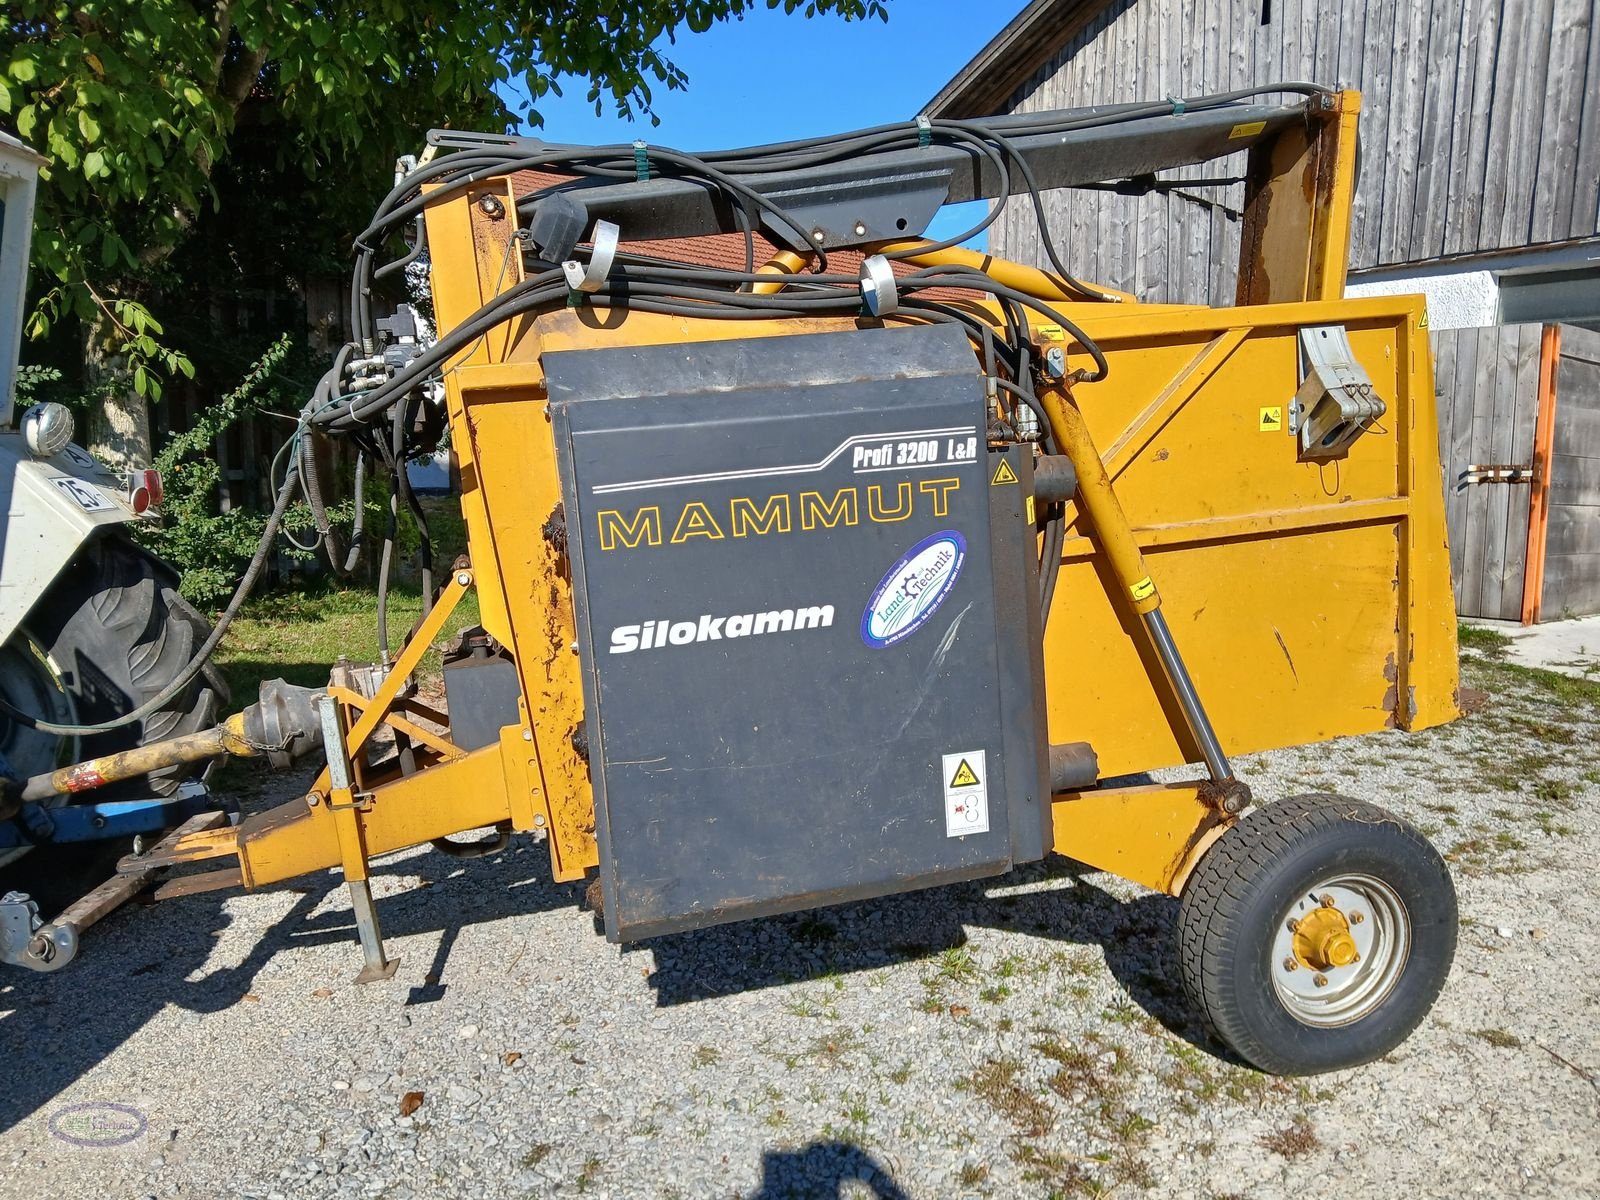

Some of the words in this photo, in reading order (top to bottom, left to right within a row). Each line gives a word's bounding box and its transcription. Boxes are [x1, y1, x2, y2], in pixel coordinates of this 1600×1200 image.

[853, 443, 892, 468] Profi
[897, 440, 938, 465] 3200
[947, 437, 977, 461] L&R
[57, 480, 100, 508] 25
[597, 477, 960, 551] MAMMUT
[912, 550, 953, 592] Technik
[877, 590, 905, 622] Land
[609, 604, 835, 654] Silokamm
